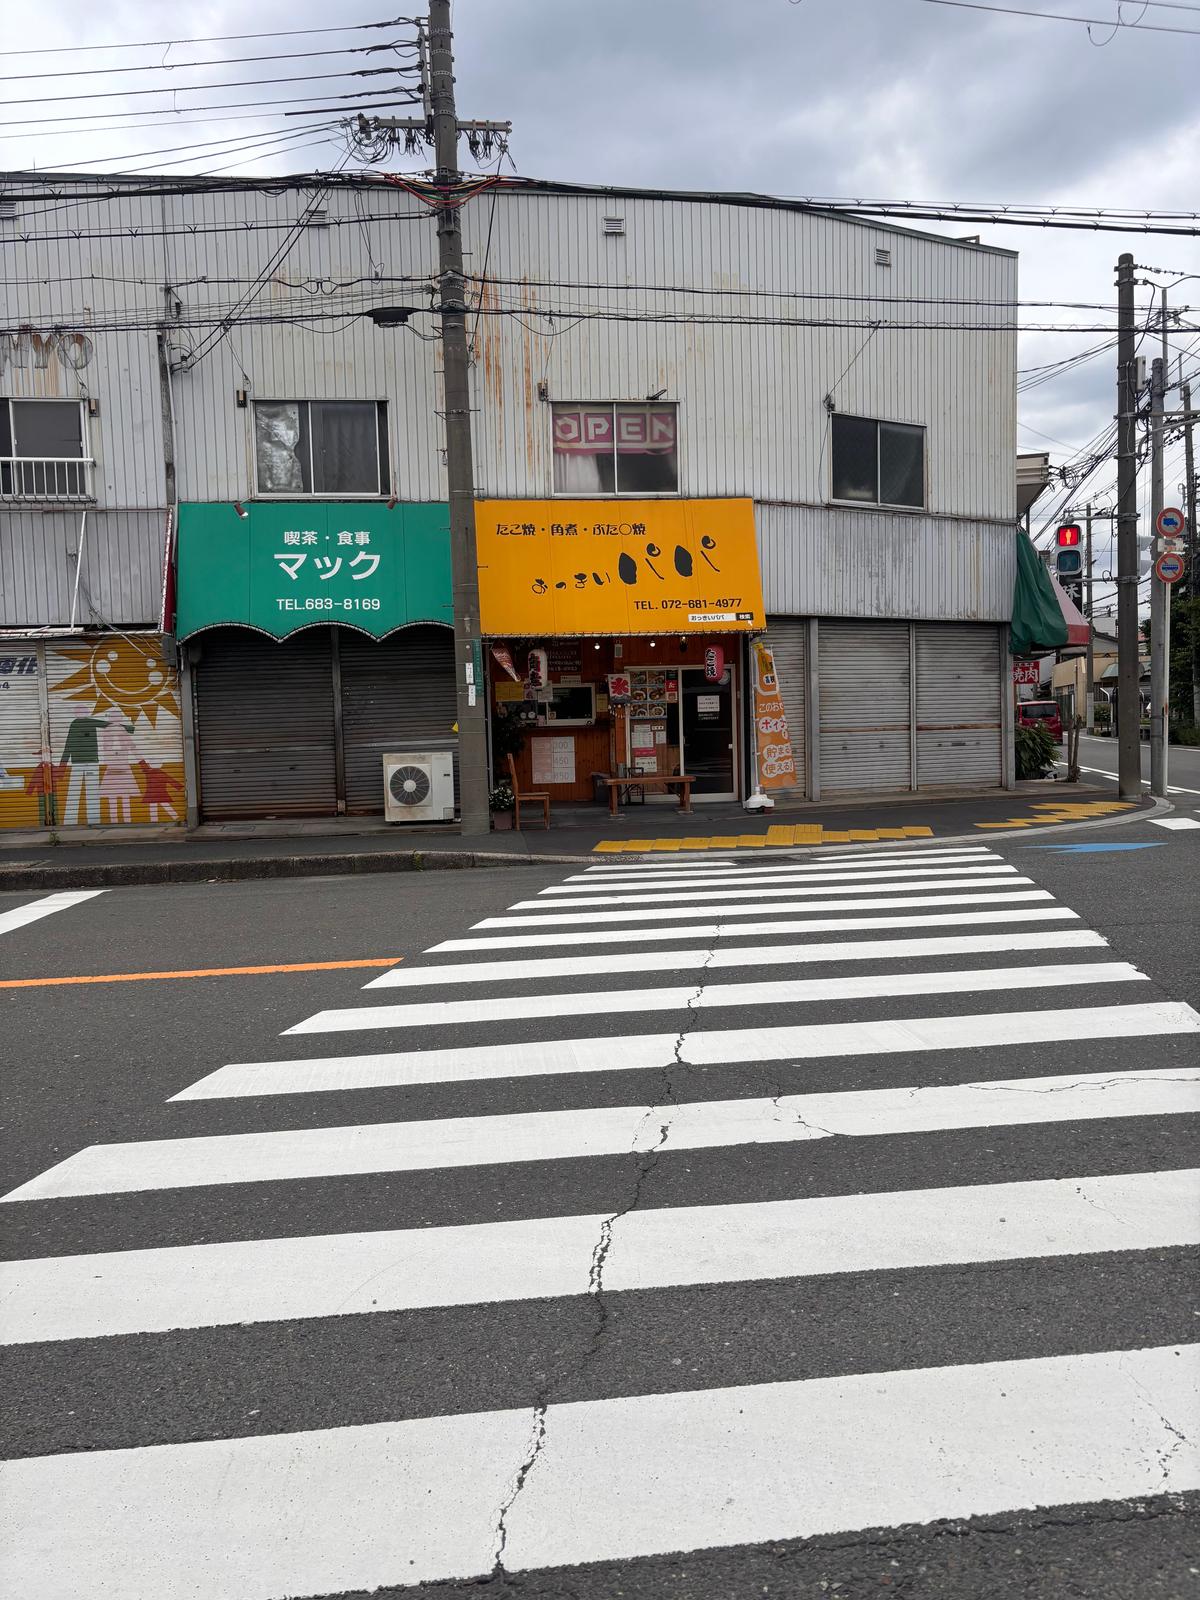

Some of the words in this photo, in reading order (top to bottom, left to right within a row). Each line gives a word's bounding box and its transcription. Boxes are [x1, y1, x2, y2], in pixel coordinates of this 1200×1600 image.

[556, 416, 673, 442] OPEN
[284, 531, 371, 545] 喫茶・食事
[274, 551, 380, 580] マック
[531, 535, 720, 594] おっきいパパ
[634, 600, 658, 610] TEL.
[661, 598, 742, 609] 072-681-4977
